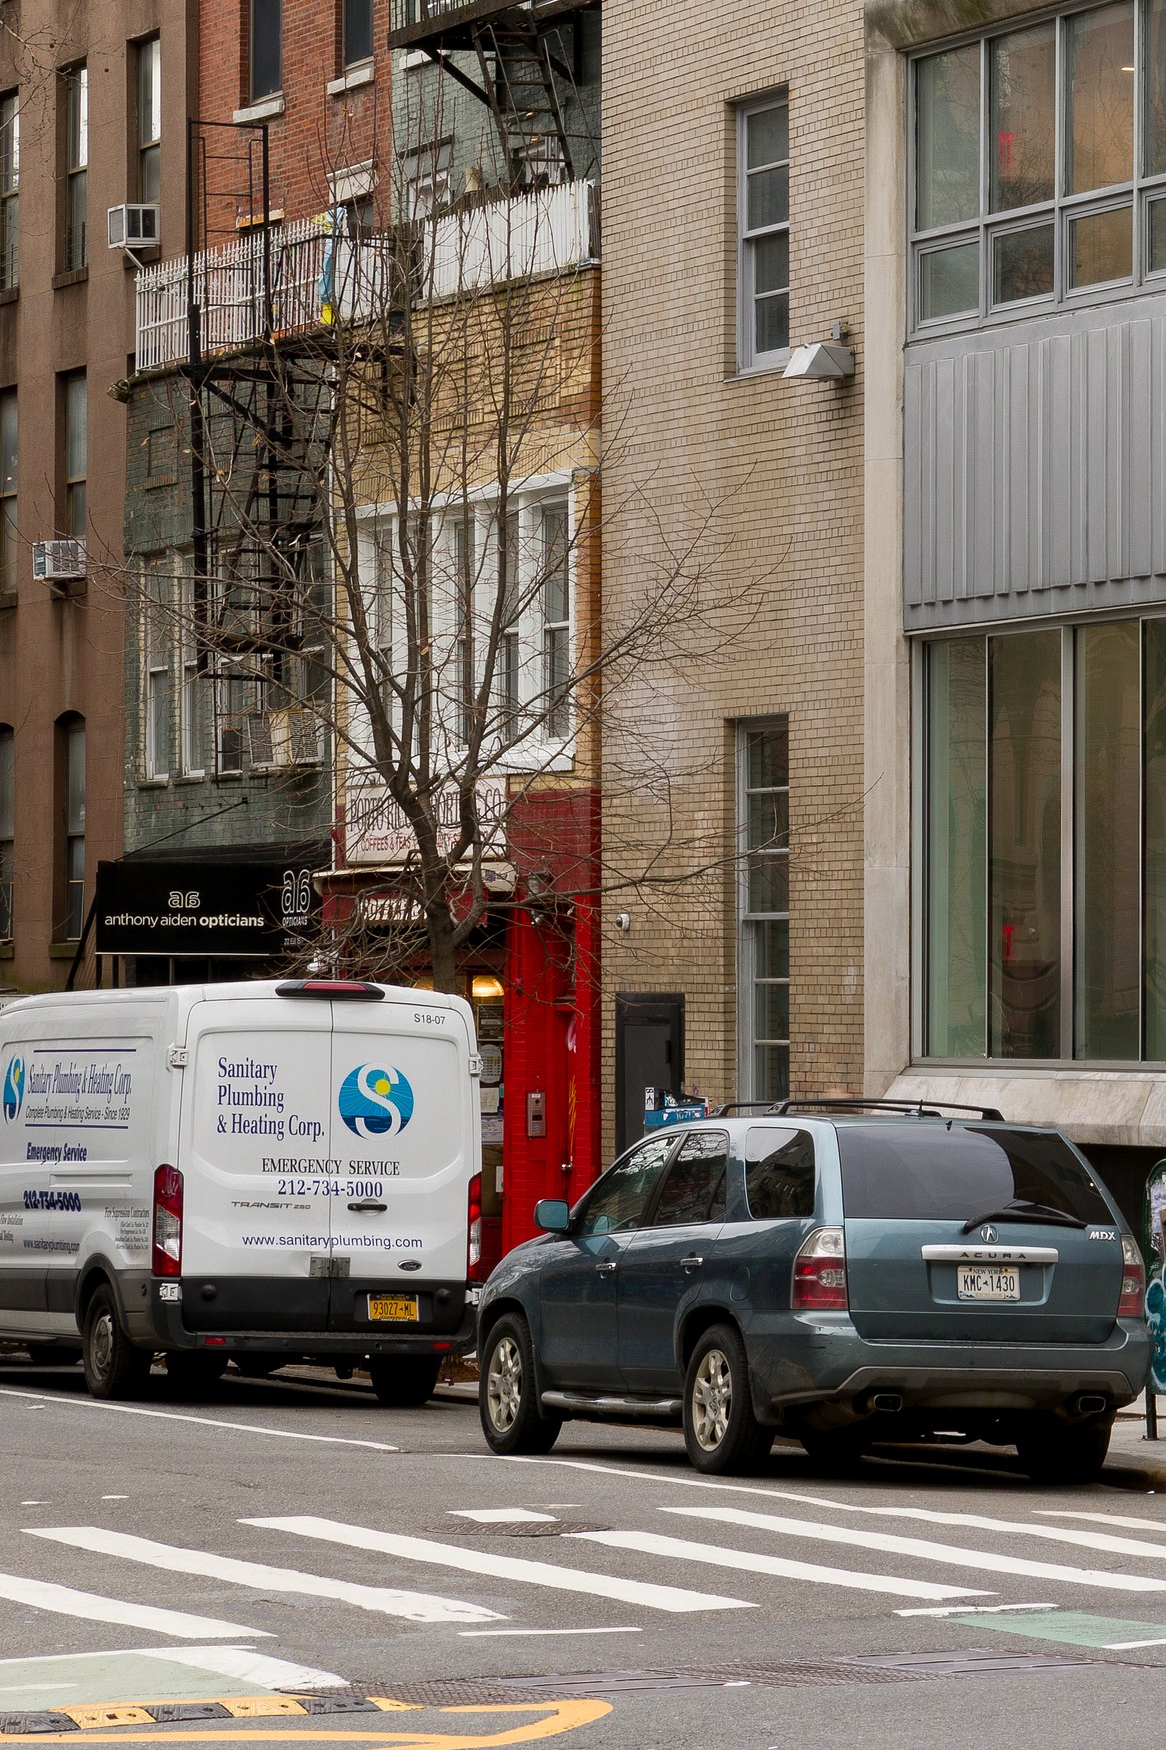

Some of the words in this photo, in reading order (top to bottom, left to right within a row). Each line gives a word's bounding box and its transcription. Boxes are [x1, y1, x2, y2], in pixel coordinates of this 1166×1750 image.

[104, 913, 158, 929] anthony
[160, 913, 197, 927] aiden
[199, 914, 265, 929] opticians
[414, 1013, 446, 1026] S18-07
[217, 1056, 278, 1086] Sanitary
[28, 1063, 54, 1103] Sanitary
[51, 1061, 82, 1103] Plumbing
[81, 1065, 89, 1094] &
[87, 1063, 114, 1104] Heating
[113, 1063, 132, 1104] Corp.
[217, 1084, 285, 1114] Plumbing
[26, 1105, 45, 1122] Complete
[44, 1105, 64, 1123] Plumbing
[68, 1106, 85, 1123] Heating
[85, 1106, 101, 1120] Service
[104, 1106, 118, 1120] Since
[118, 1107, 131, 1121] 1929
[216, 1113, 228, 1134] &
[231, 1113, 285, 1142] Heating
[288, 1114, 325, 1143] Corp.
[26, 1142, 63, 1166] Emergency
[63, 1142, 88, 1162] Service
[261, 1157, 343, 1175] EMERGENCY
[348, 1159, 400, 1176] SERVICE
[277, 1179, 383, 1198] 212-734-5000
[23, 1190, 82, 1213] 212-734-5000
[231, 1201, 293, 1210] TRANSIT
[241, 1234, 423, 1250] www.sanitaryplumbing.com
[1089, 1230, 1116, 1242] MDX
[23, 1239, 80, 1255] www.sanitaryplumbing.com
[960, 1251, 1027, 1259] ACURA
[963, 1275, 982, 1292] KMC
[989, 1275, 1015, 1292] 1430
[373, 1301, 399, 1316] 93027
